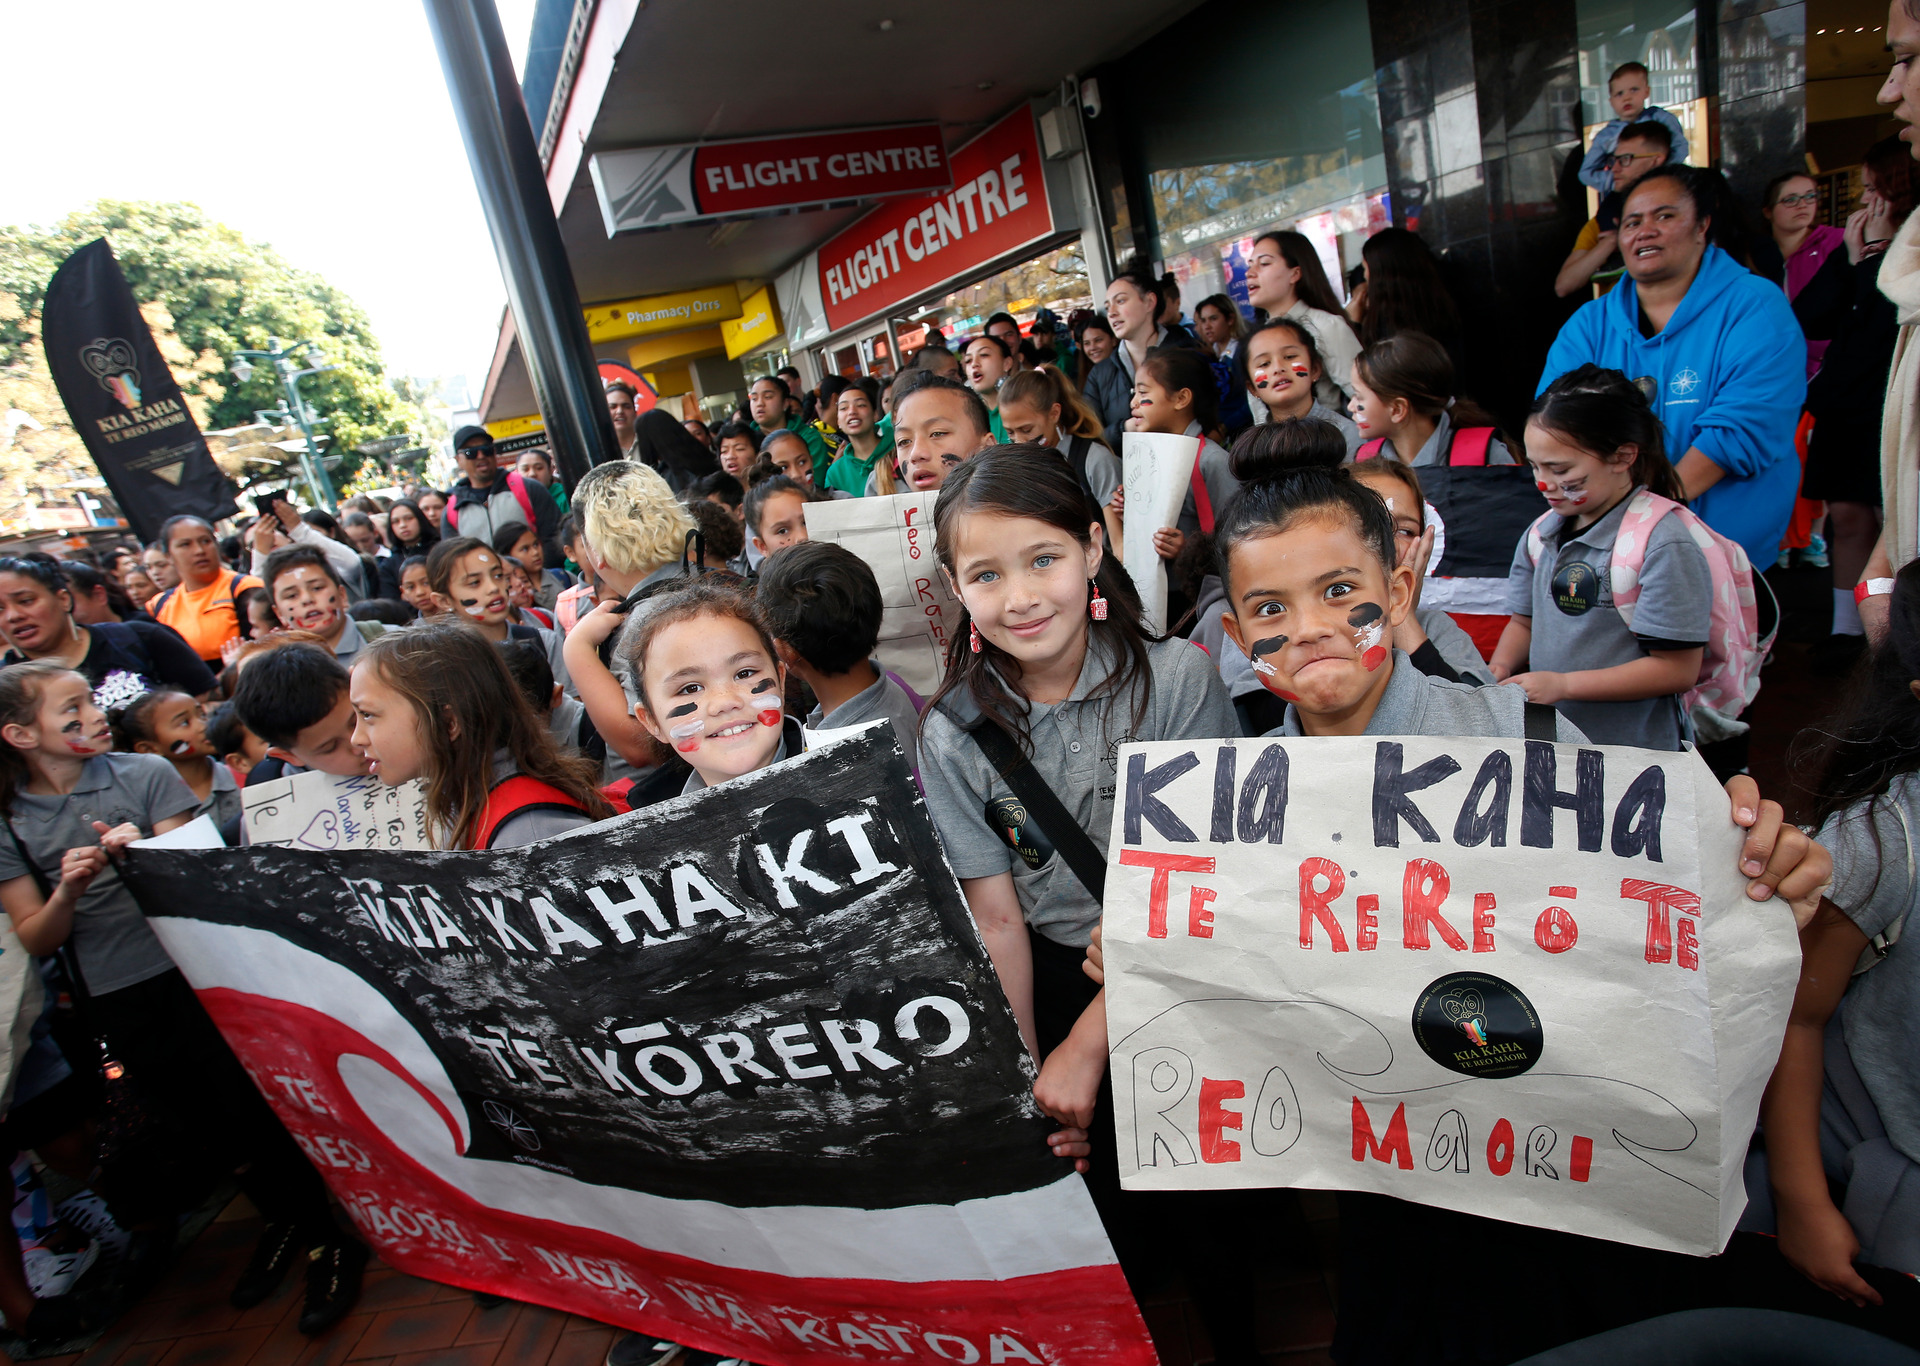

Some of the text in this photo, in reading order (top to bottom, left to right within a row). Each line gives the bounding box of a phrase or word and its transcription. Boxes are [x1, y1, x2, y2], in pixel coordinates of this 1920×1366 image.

[705, 145, 941, 193] FLIGHT CENTRE
[825, 153, 1028, 306] FLIGHT CENTRE
[627, 300, 721, 325] Pharmacy Orrs
[96, 399, 181, 432] KIA KAHA
[245, 779, 295, 825] Te
[360, 809, 900, 955] KIA KAHA KI
[1119, 849, 1217, 939] TE
[1620, 877, 1702, 971] TE
[473, 995, 971, 1098] TE KŌRERO
[1453, 1042, 1524, 1061] KIA KAHA
[1459, 1061, 1473, 1069] TE
[1473, 1058, 1493, 1067] REO
[274, 1074, 329, 1114] TE
[1132, 1046, 1302, 1170] REO
[293, 1133, 371, 1169] REO
